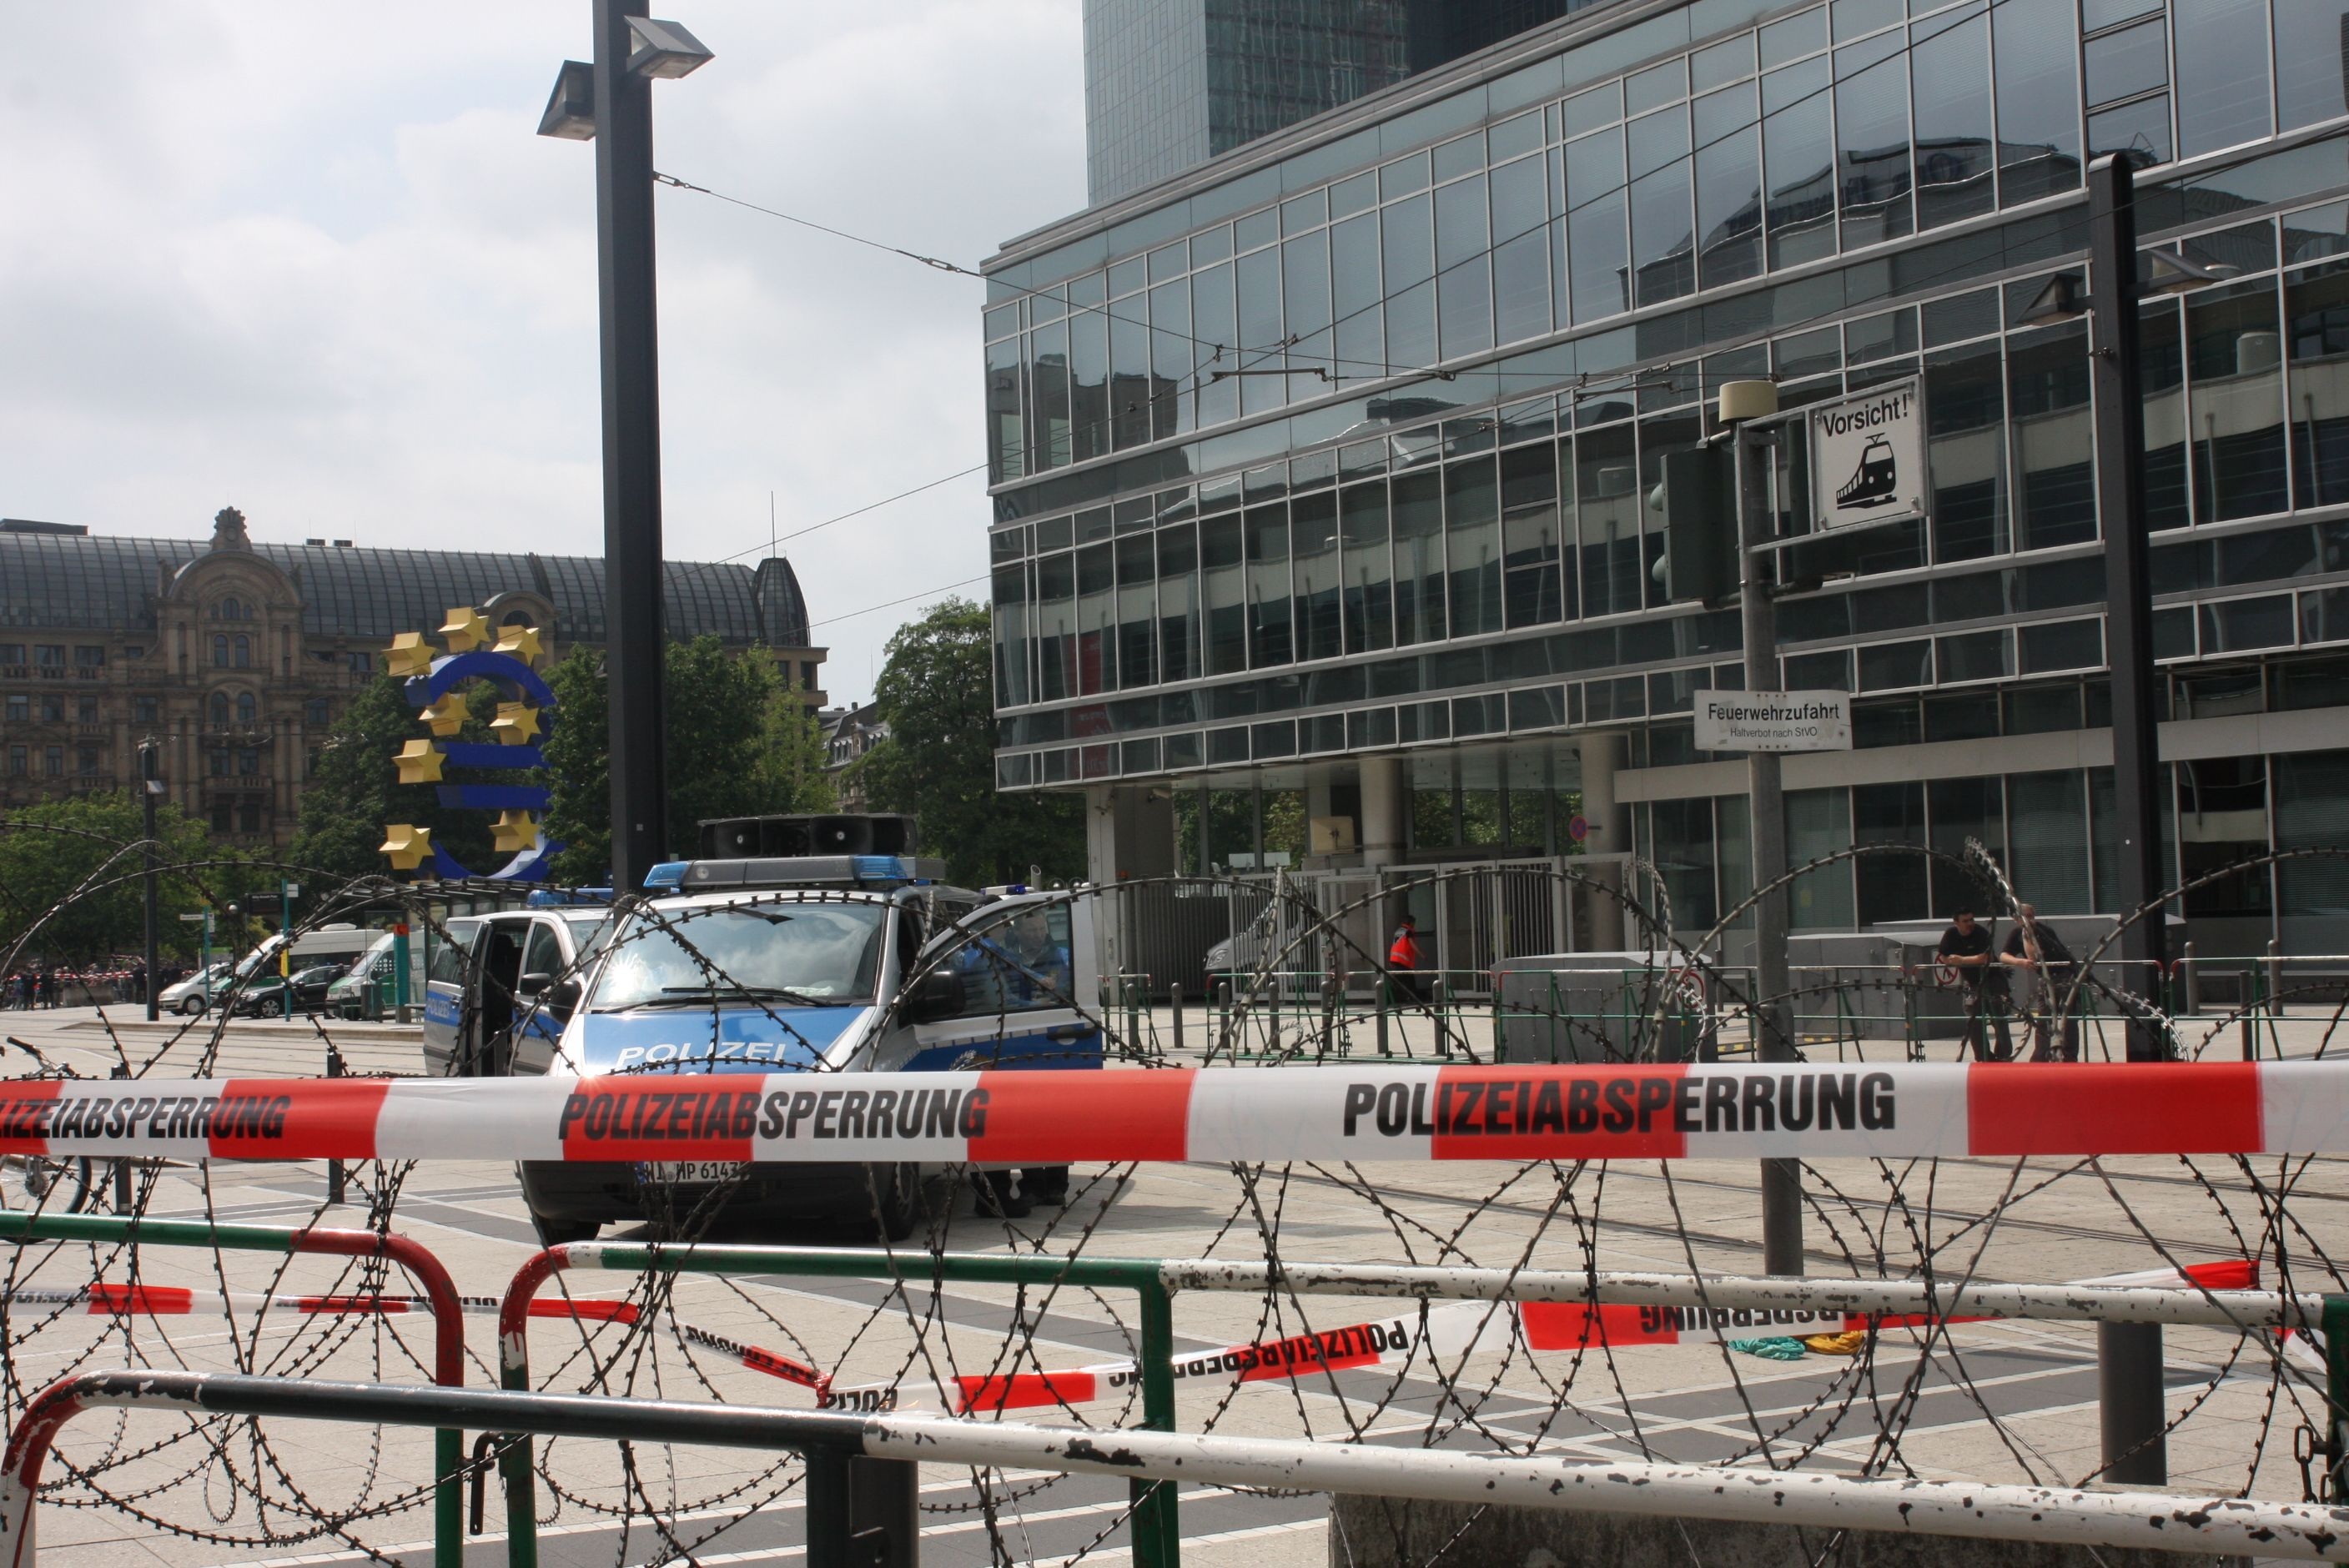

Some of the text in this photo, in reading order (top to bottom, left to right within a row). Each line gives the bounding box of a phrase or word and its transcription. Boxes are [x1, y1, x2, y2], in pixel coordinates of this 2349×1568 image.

[1823, 393, 1908, 438] Vorsicht!
[1708, 703, 1840, 721] Feuerwehrzufahrt
[1730, 726, 1818, 738] Haltverbot nach StVO
[614, 1042, 786, 1071] POLIZEI
[558, 1088, 989, 1141] POLIZEIABSPERRUNG
[1343, 1072, 1896, 1137] POLIZEIABSPERRUNG
